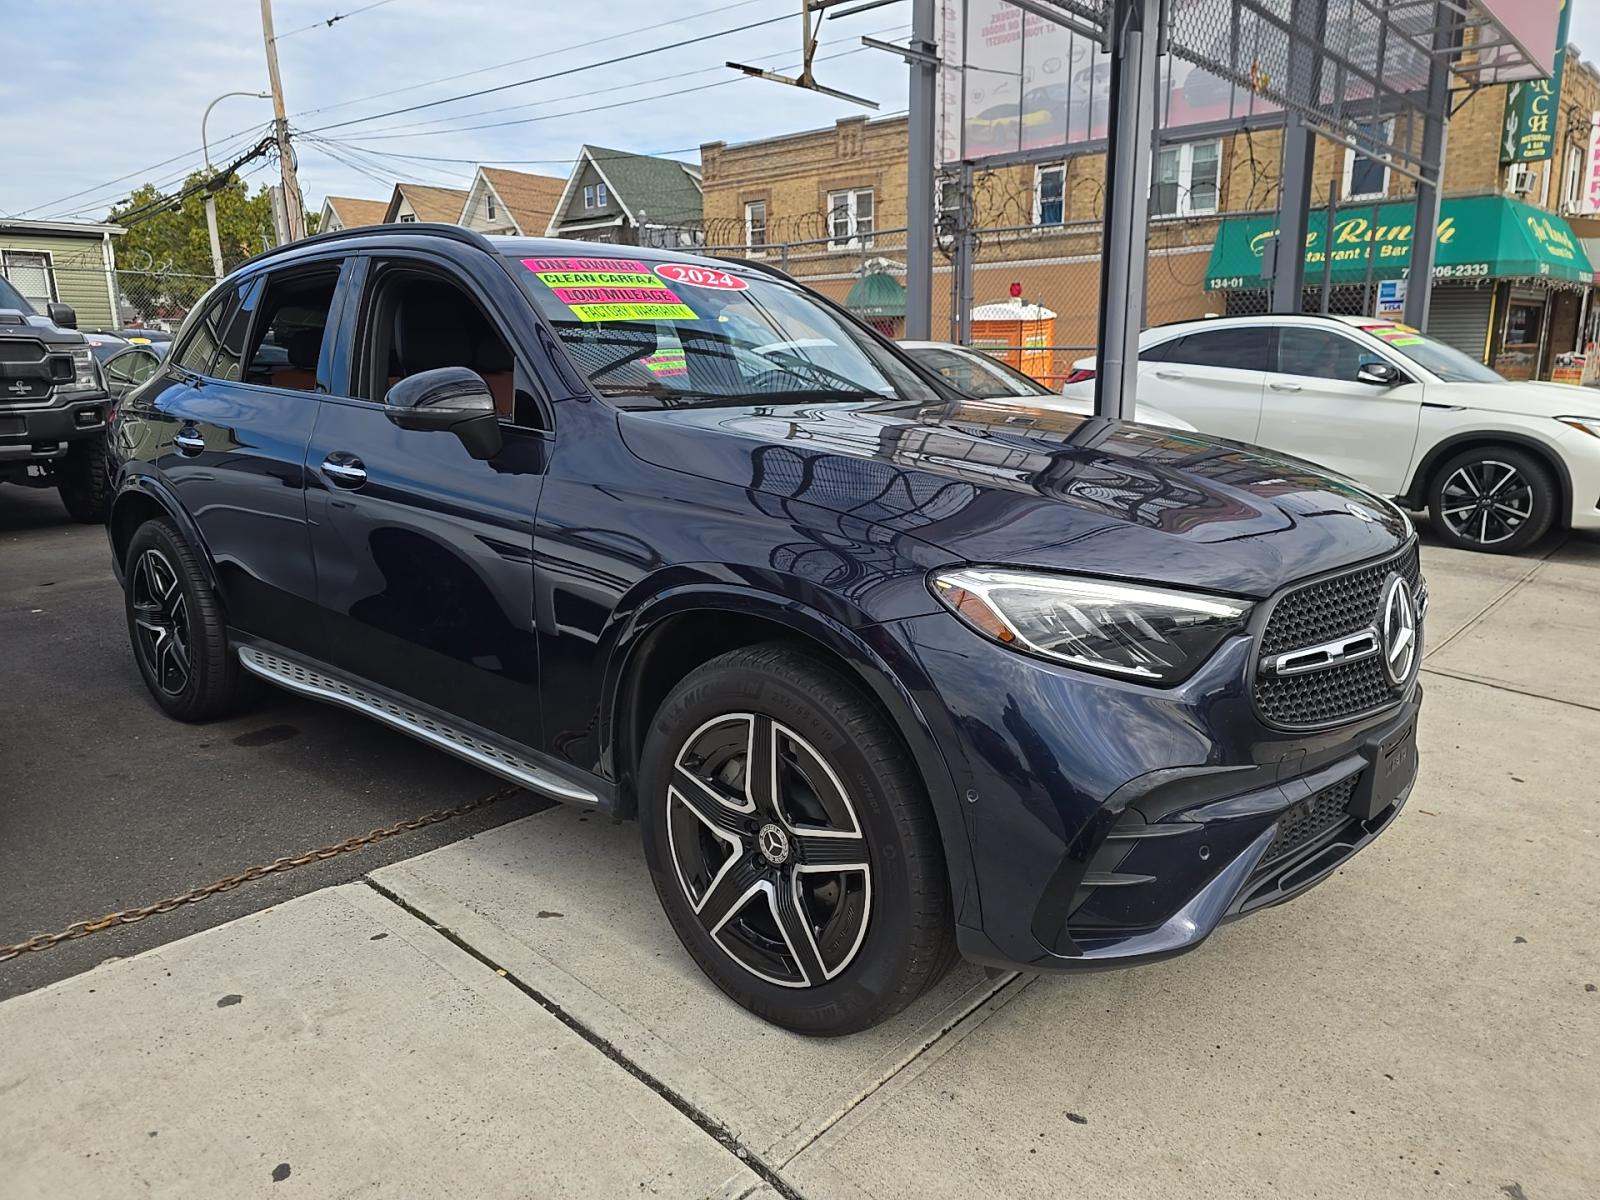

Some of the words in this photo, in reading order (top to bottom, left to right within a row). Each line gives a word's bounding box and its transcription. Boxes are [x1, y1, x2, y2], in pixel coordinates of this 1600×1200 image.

[1333, 217, 1455, 244] Ranh
[1305, 248, 1361, 262] taurant
[1380, 244, 1409, 257] Bar
[536, 260, 575, 271] ONE
[577, 260, 637, 271] OWNER
[543, 274, 597, 284] CLEAN
[598, 274, 656, 284] CARFAX
[672, 267, 734, 287] 2024
[1210, 278, 1243, 289] 134-01
[565, 289, 601, 301] LOW
[603, 289, 672, 301] MILEAGE
[580, 305, 630, 318] FACTORY
[632, 304, 692, 317] WARRANTY
